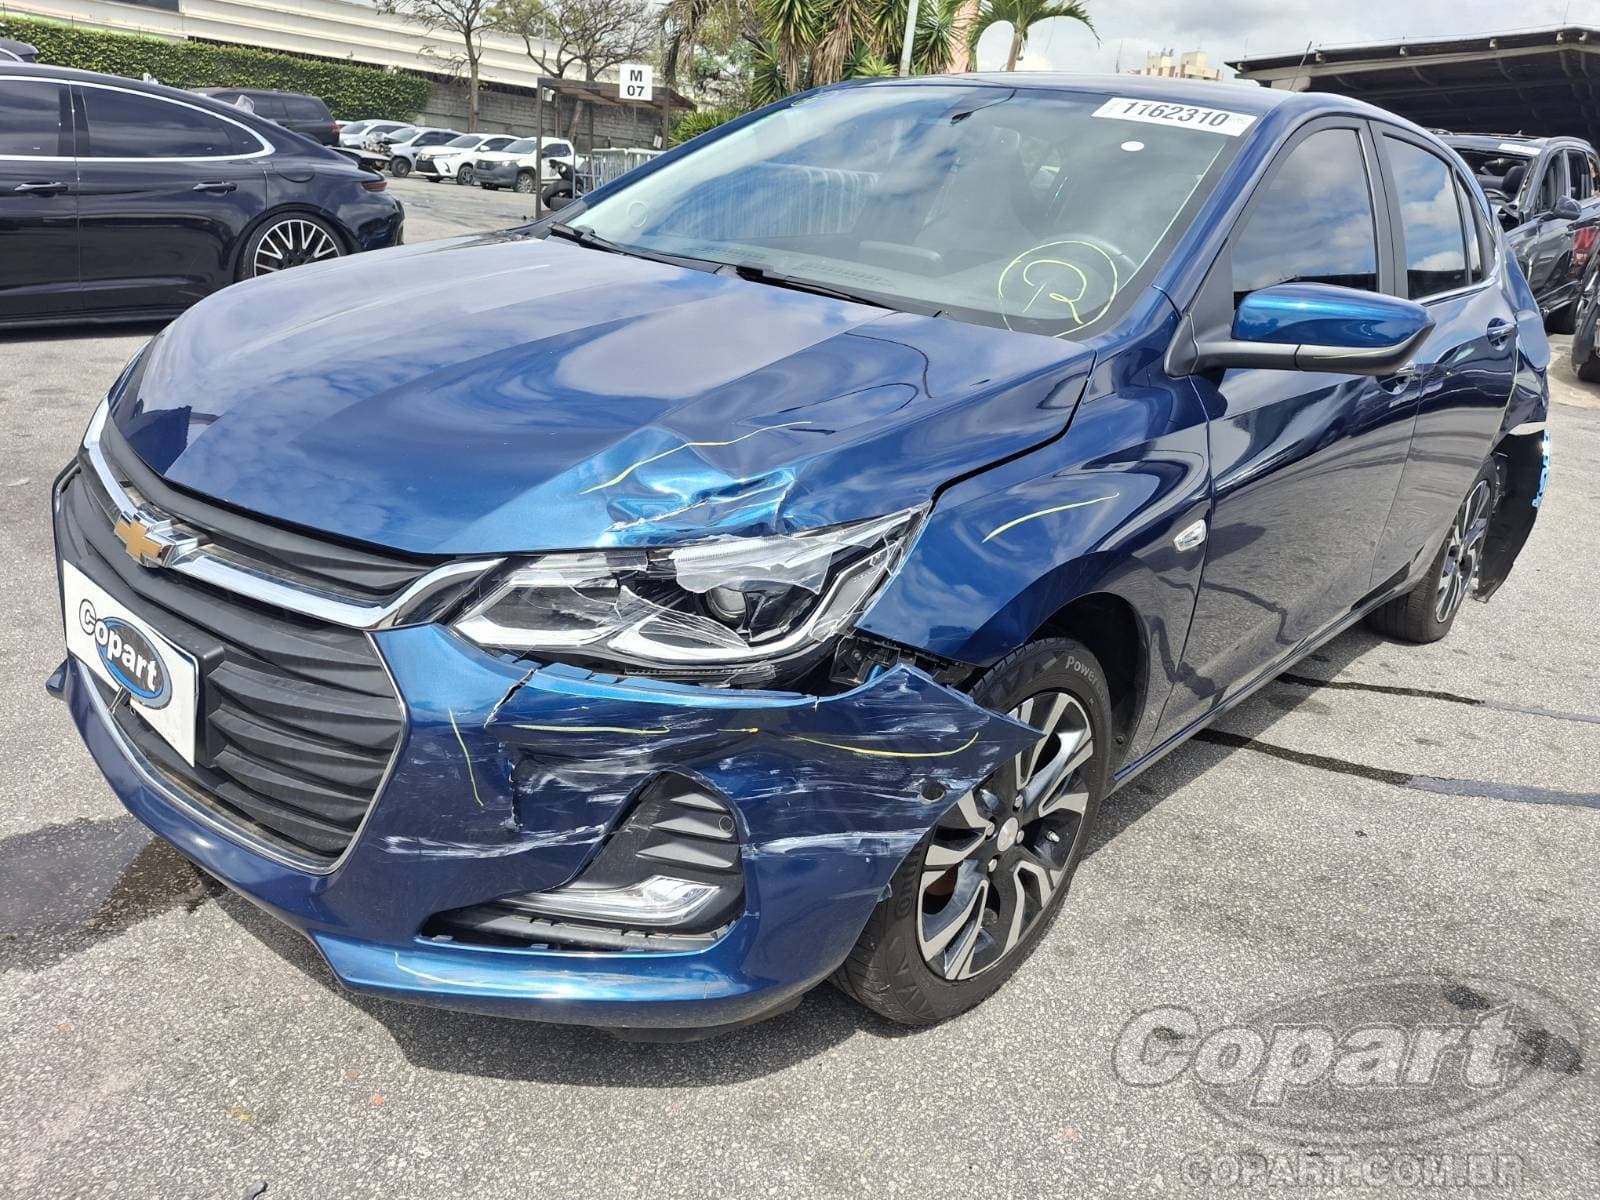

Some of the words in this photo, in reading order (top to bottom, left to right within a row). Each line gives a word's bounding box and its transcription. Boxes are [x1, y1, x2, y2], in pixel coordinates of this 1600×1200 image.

[630, 69, 643, 82] M
[627, 85, 645, 97] 07
[1122, 101, 1230, 127] 1162310
[79, 598, 158, 694] Copart
